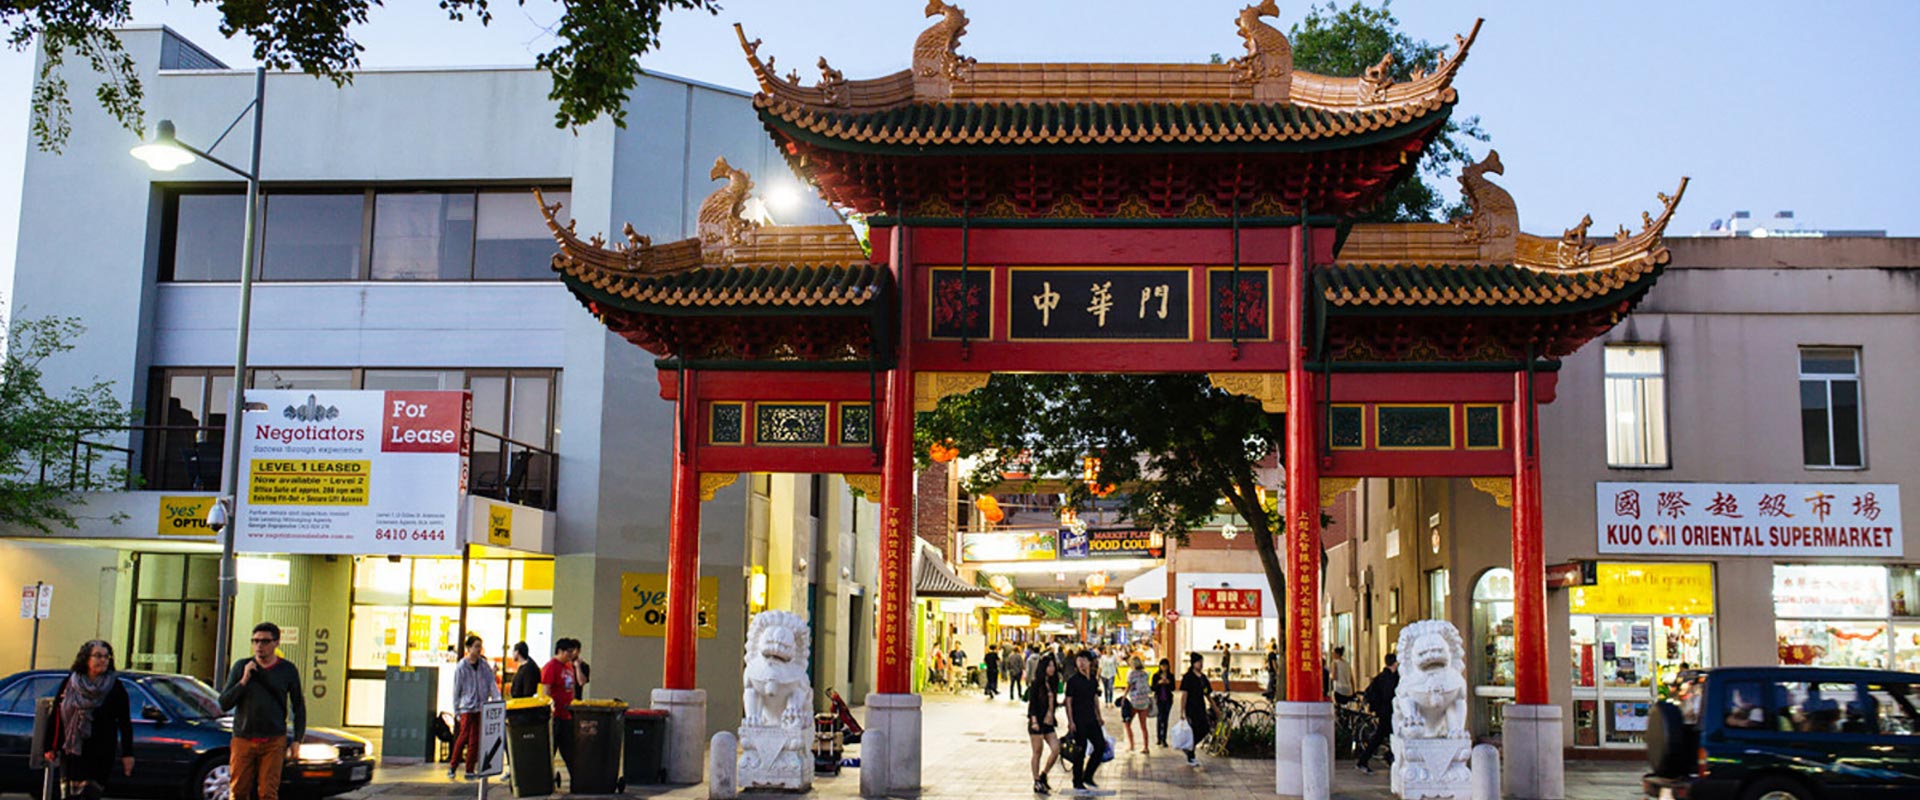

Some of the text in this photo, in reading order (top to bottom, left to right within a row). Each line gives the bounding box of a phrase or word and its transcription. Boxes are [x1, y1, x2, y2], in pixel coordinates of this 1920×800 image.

[1032, 280, 1170, 328] 中華門
[392, 400, 428, 418] For
[255, 424, 365, 444] Negotiators
[391, 425, 456, 444] Lease
[258, 463, 361, 473] LEVEL 1 LEASED
[254, 476, 276, 484] Now
[278, 477, 321, 485] available
[1614, 489, 1882, 523] 國際超級市場
[173, 518, 210, 528] OPTU
[375, 528, 445, 540] 8410 6444
[1094, 532, 1127, 540] MARKET
[1606, 524, 1642, 546] KUO
[1681, 525, 1764, 547] ORIENTAL
[1769, 526, 1894, 548] SUPERMARKET
[1089, 539, 1120, 550] FOOD
[632, 583, 666, 610] 'ye
[312, 628, 329, 699] OPTUS
[486, 707, 502, 720] KEEP
[485, 723, 501, 736] LEFT
